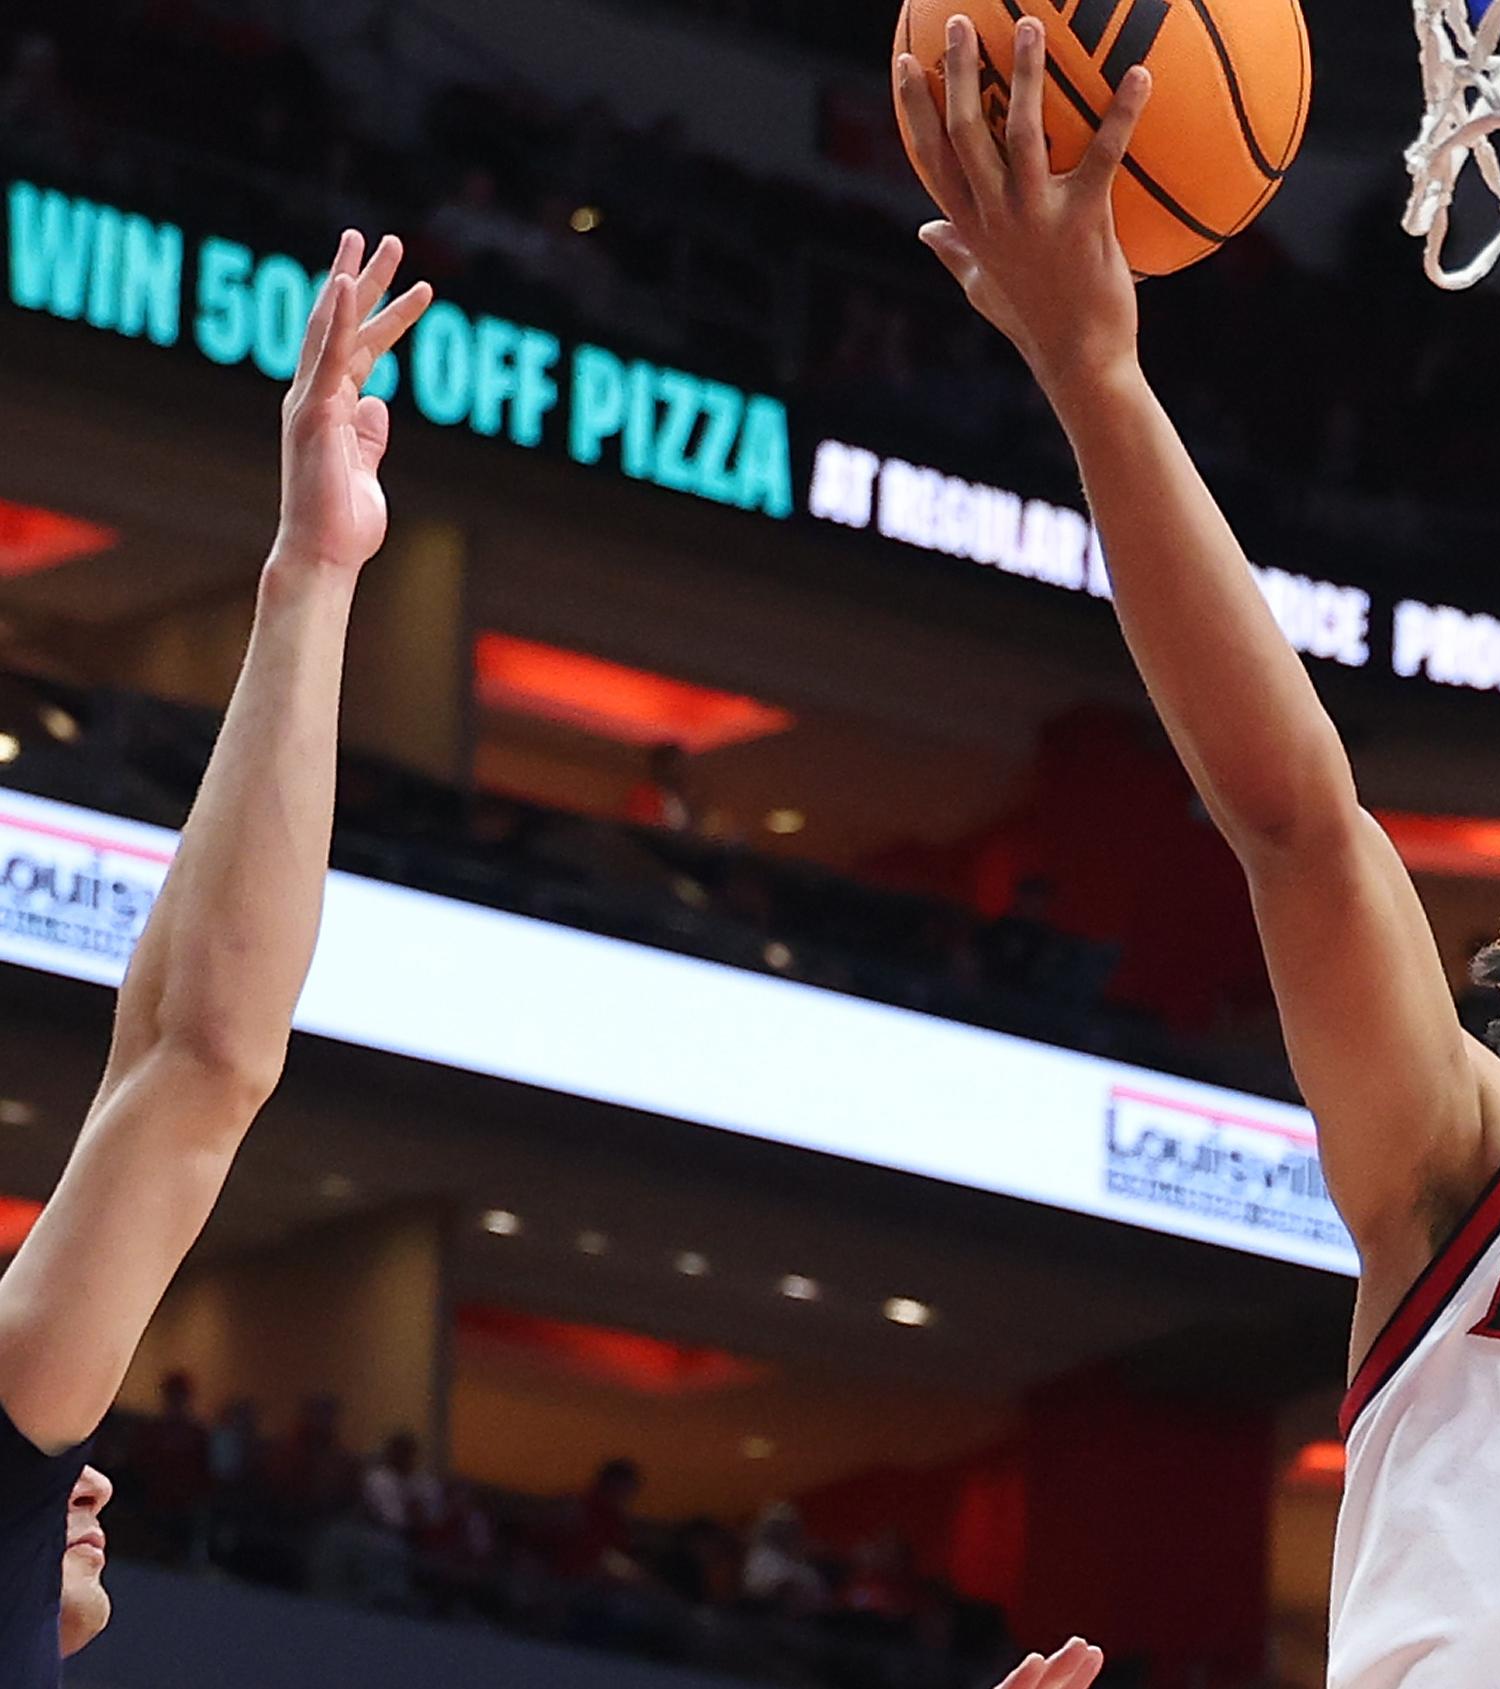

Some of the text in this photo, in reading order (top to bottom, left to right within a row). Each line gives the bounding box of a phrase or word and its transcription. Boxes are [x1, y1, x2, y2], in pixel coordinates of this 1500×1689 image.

[8, 180, 793, 519] WIN 50 OFF PIZZA
[809, 439, 880, 528] AT
[1247, 562, 1371, 667] RICE
